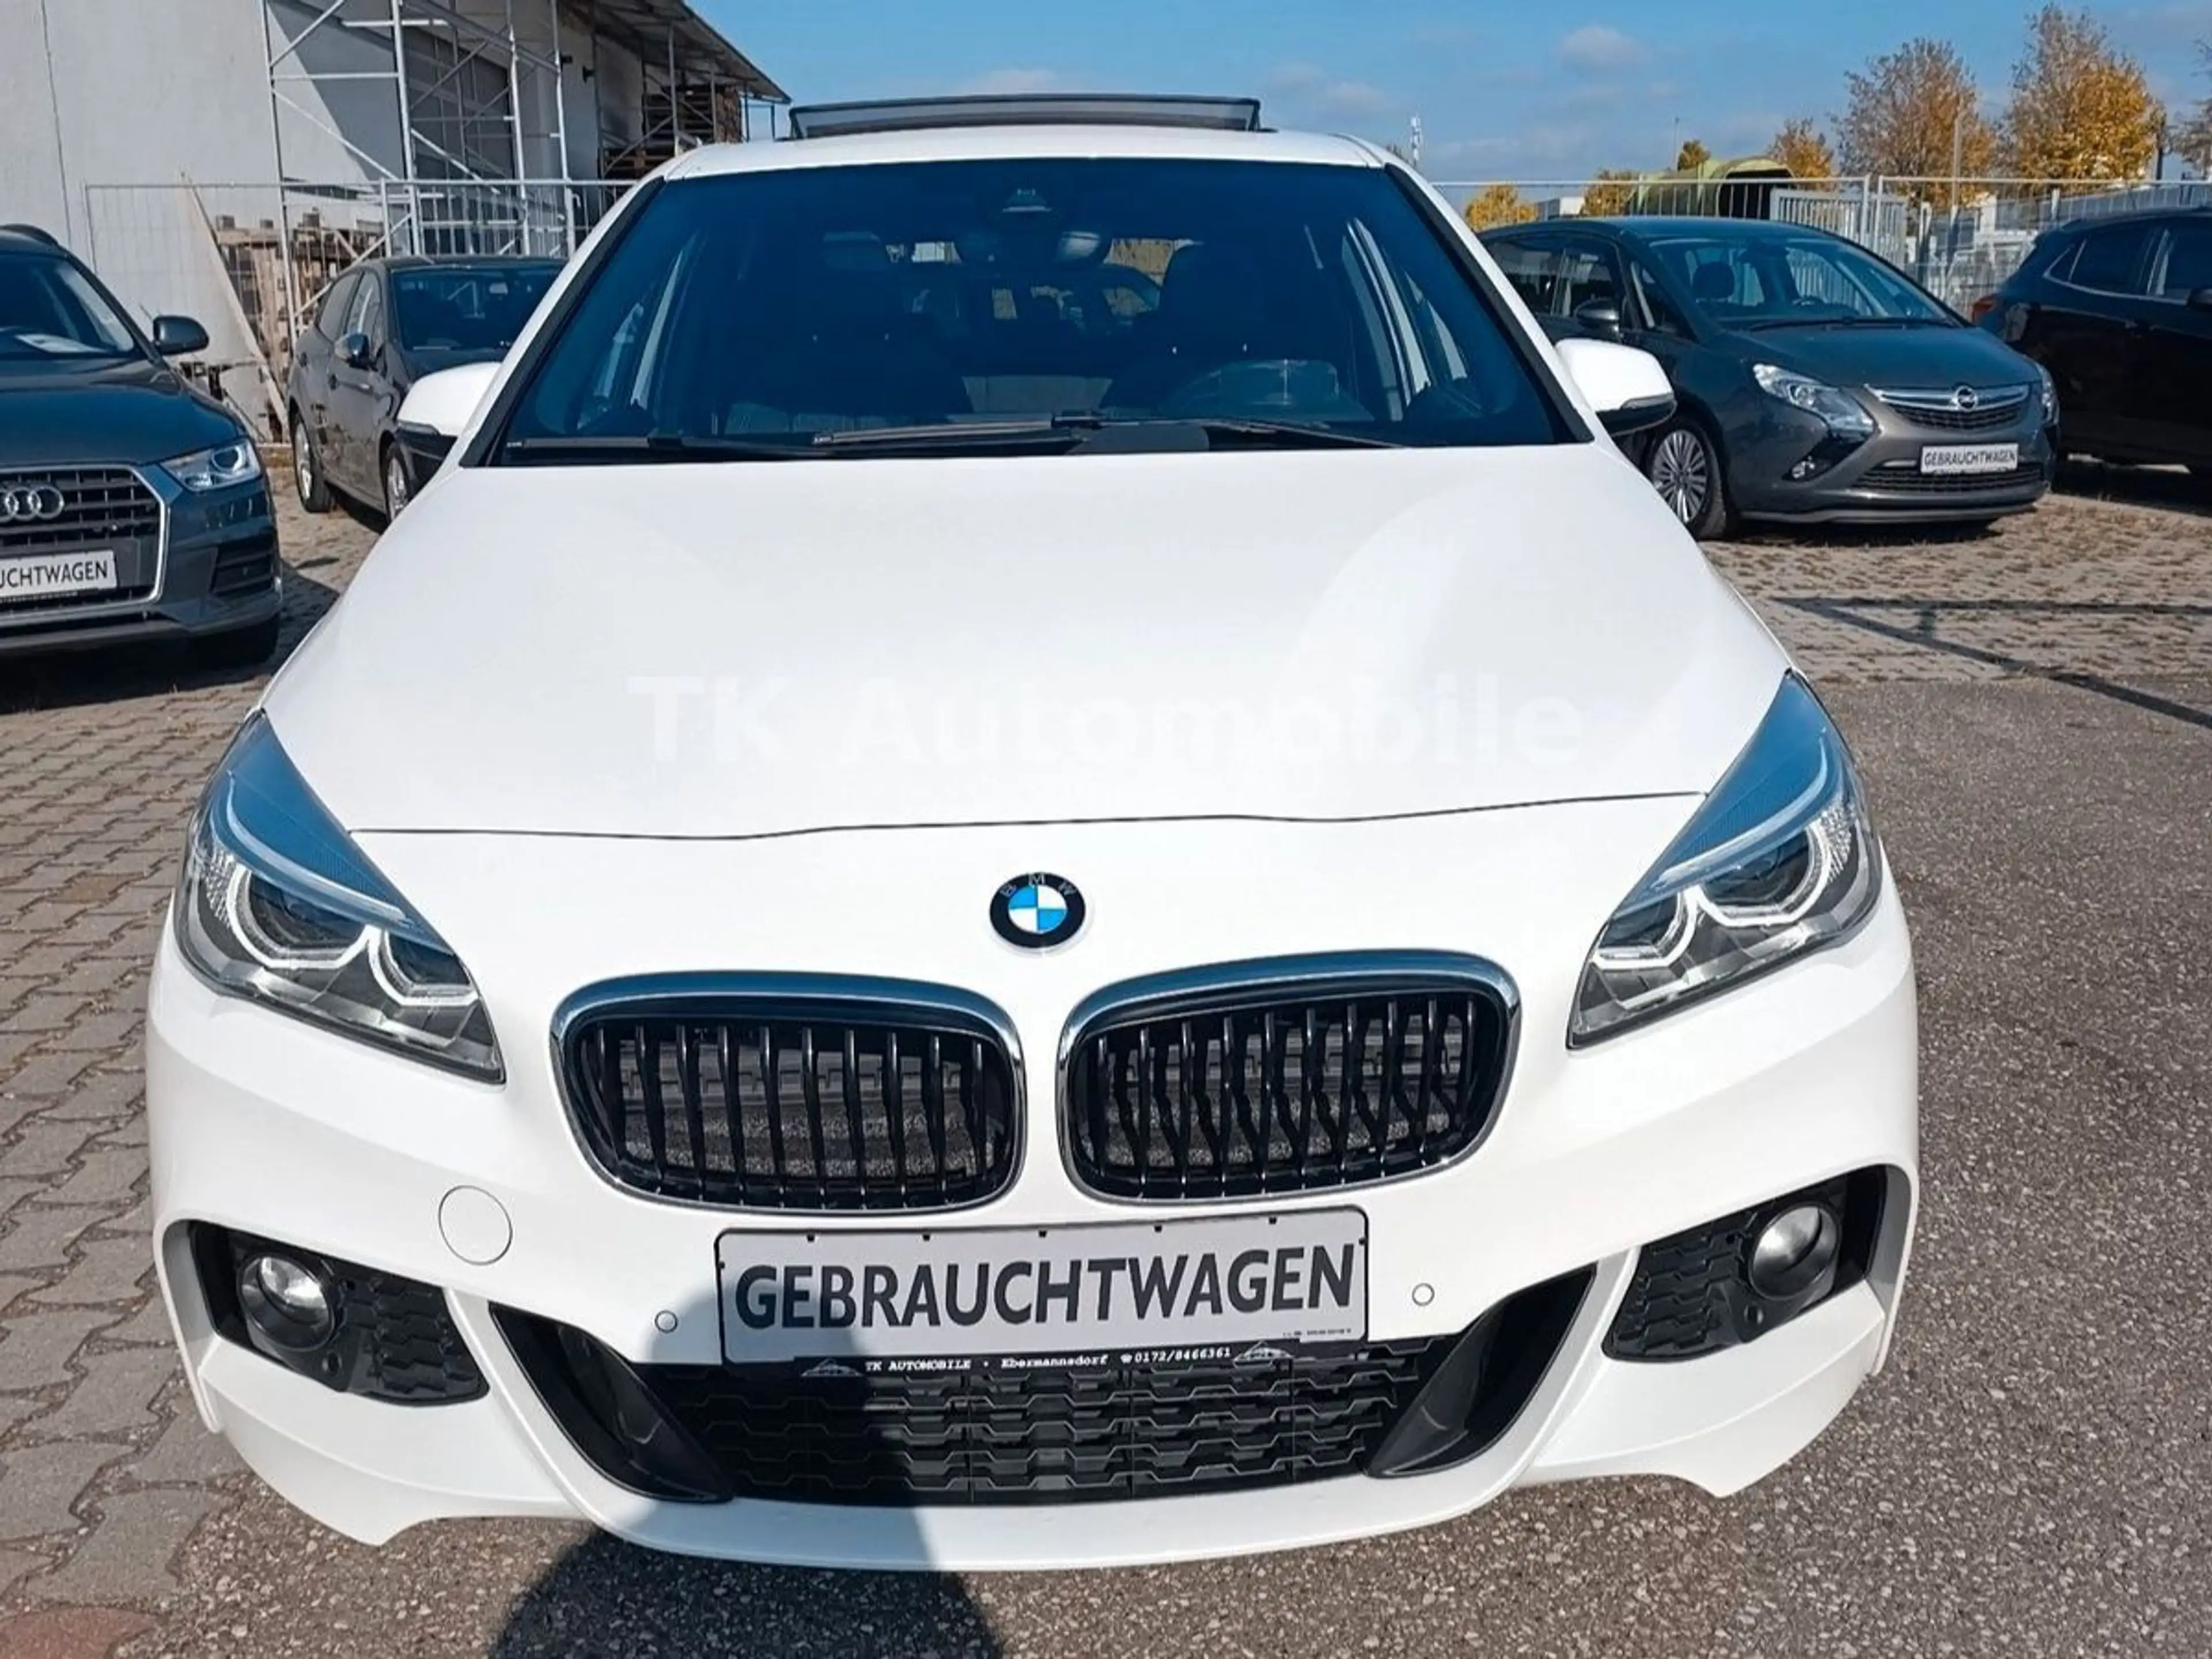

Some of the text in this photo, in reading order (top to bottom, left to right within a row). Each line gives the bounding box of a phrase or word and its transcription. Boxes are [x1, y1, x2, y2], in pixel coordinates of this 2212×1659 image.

[999, 872, 1077, 898] BMW
[735, 1244, 1355, 1330] GEBRAUCHTWAGEN
[865, 1361, 882, 1372] TK
[888, 1358, 972, 1372] AUTOMOBILE
